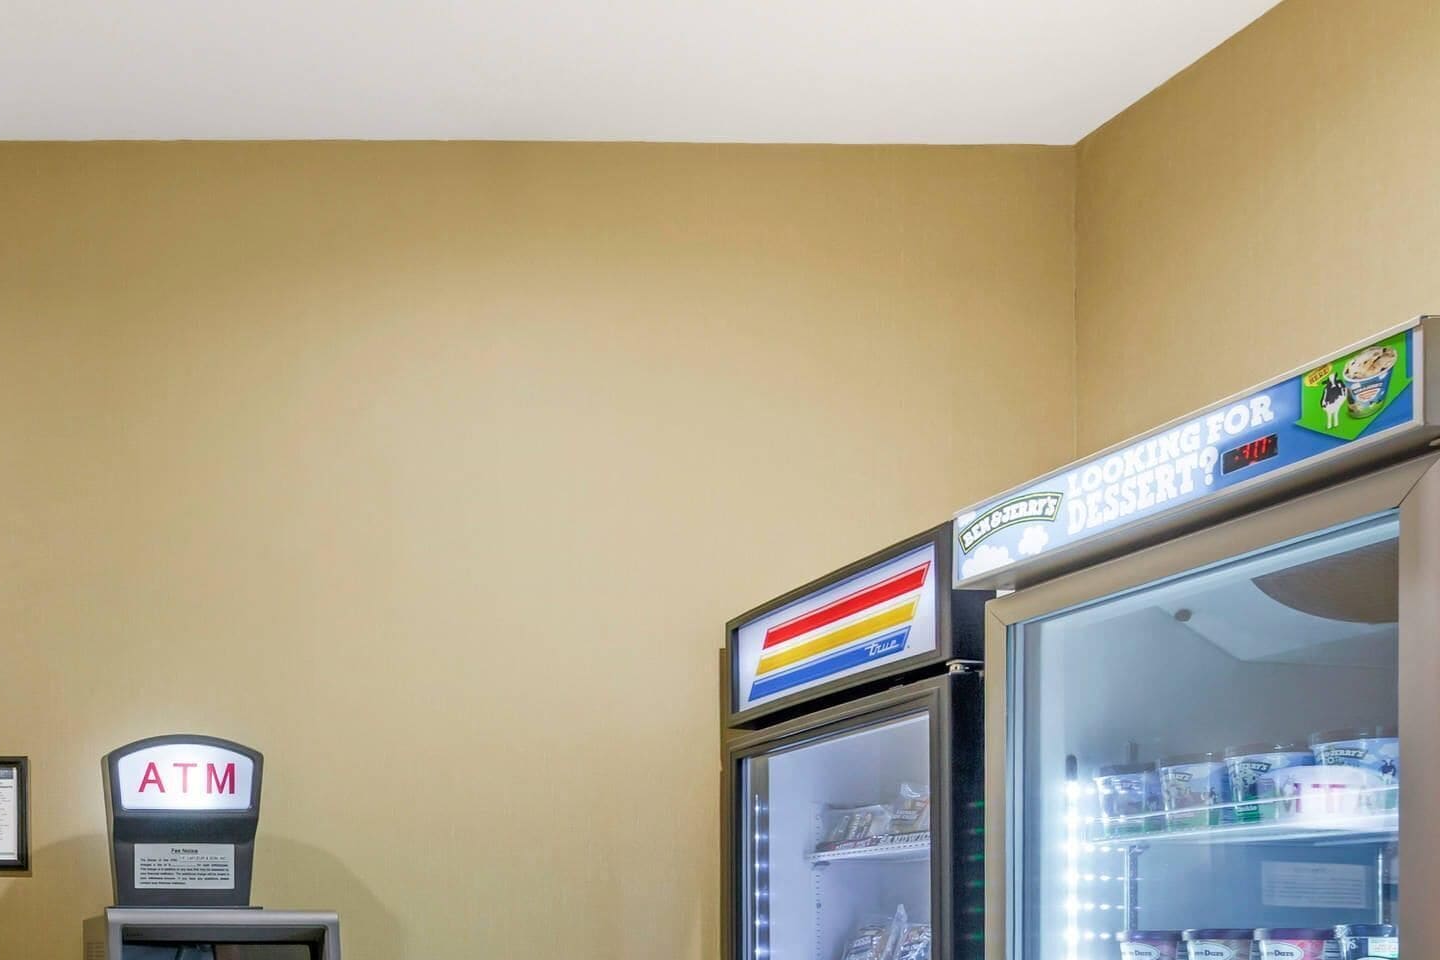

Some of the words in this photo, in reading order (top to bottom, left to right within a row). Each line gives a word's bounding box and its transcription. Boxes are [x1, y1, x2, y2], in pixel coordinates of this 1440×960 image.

[1068, 421, 1201, 496] LOOKING
[1207, 395, 1274, 443] FOR
[1067, 446, 1219, 534] DESSERT?
[138, 762, 235, 794] ATM
